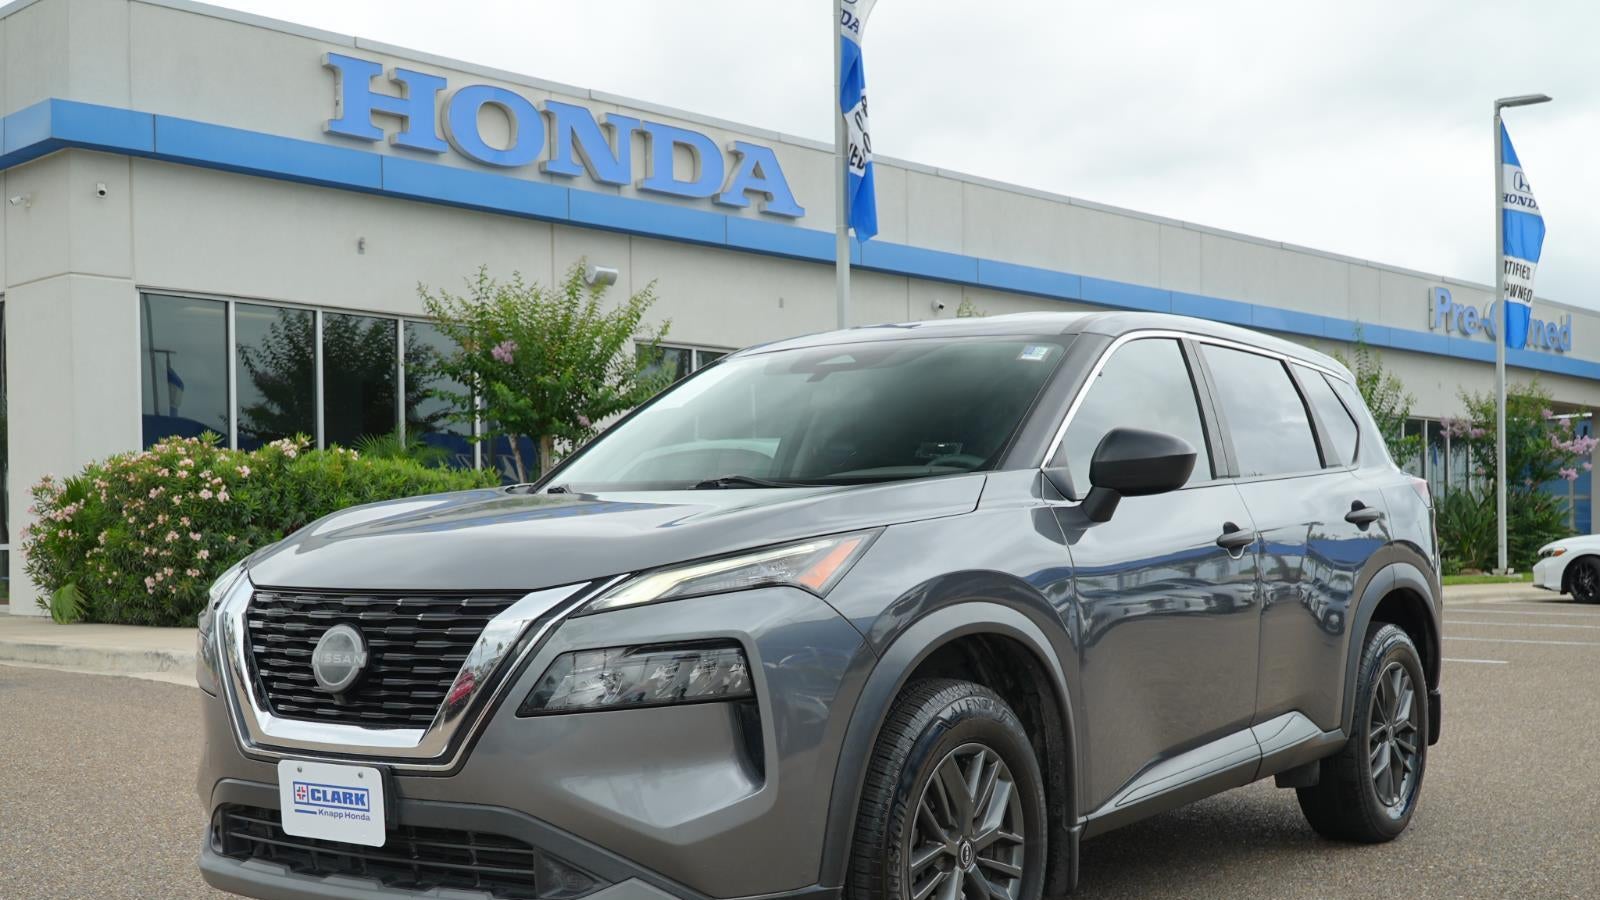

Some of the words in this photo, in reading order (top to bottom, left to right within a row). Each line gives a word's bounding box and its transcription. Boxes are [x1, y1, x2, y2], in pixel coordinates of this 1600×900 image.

[321, 52, 805, 218] HONDA
[1503, 192, 1540, 210] HOND
[1429, 286, 1572, 353] Pre-ned
[310, 788, 366, 806] CLARK
[318, 809, 344, 820] Knapp
[345, 811, 371, 822] Honda
